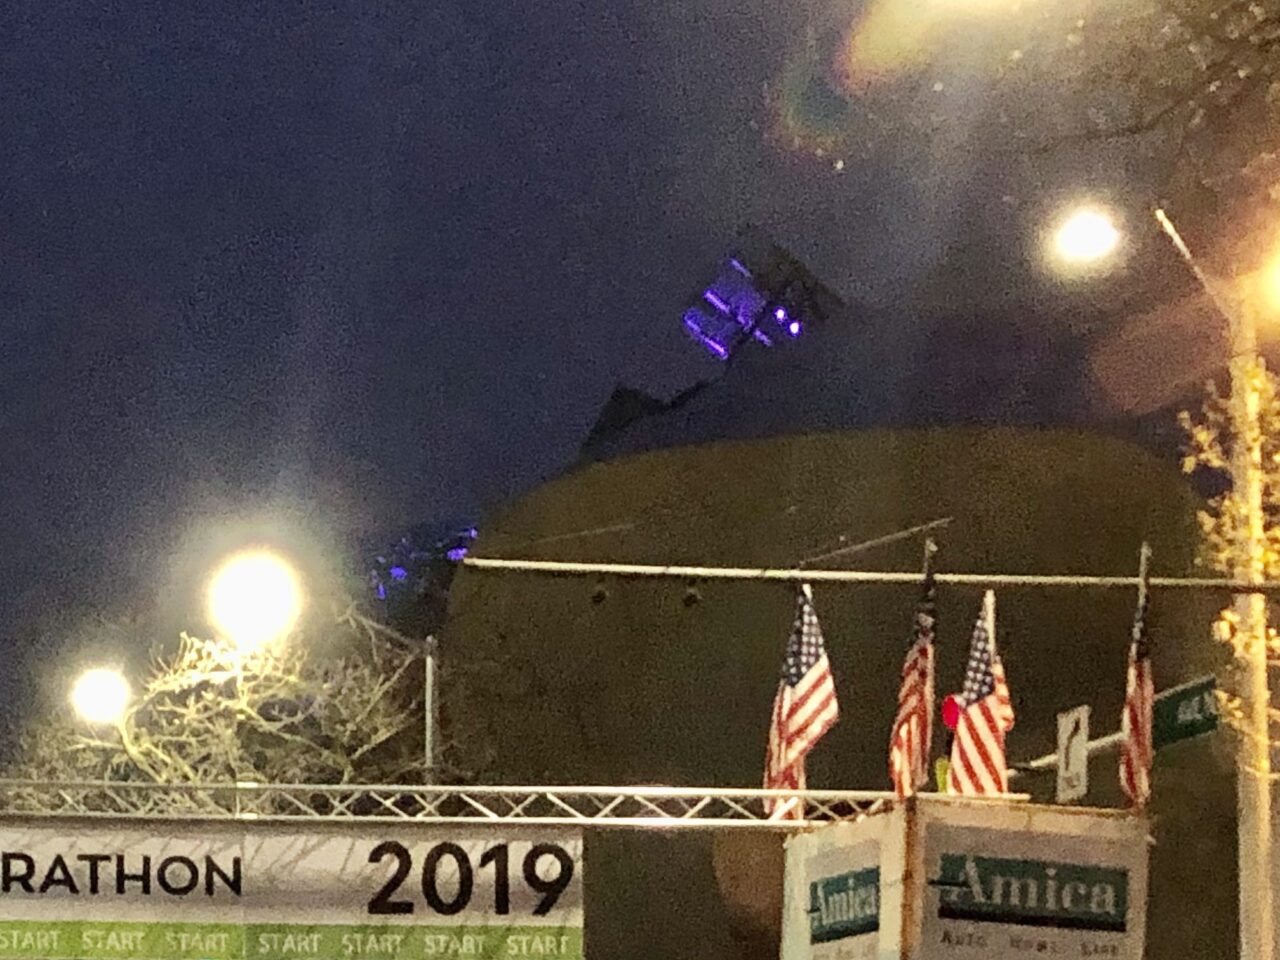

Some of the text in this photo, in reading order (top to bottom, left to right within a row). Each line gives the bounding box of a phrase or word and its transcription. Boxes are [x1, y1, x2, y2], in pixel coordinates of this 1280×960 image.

[367, 840, 575, 917] 2019
[942, 855, 1116, 914] Amica
[81, 930, 146, 952] START
[166, 931, 229, 953] START
[258, 932, 321, 953] START
[342, 933, 403, 954] START
[424, 934, 486, 955] START
[506, 934, 569, 955] START
